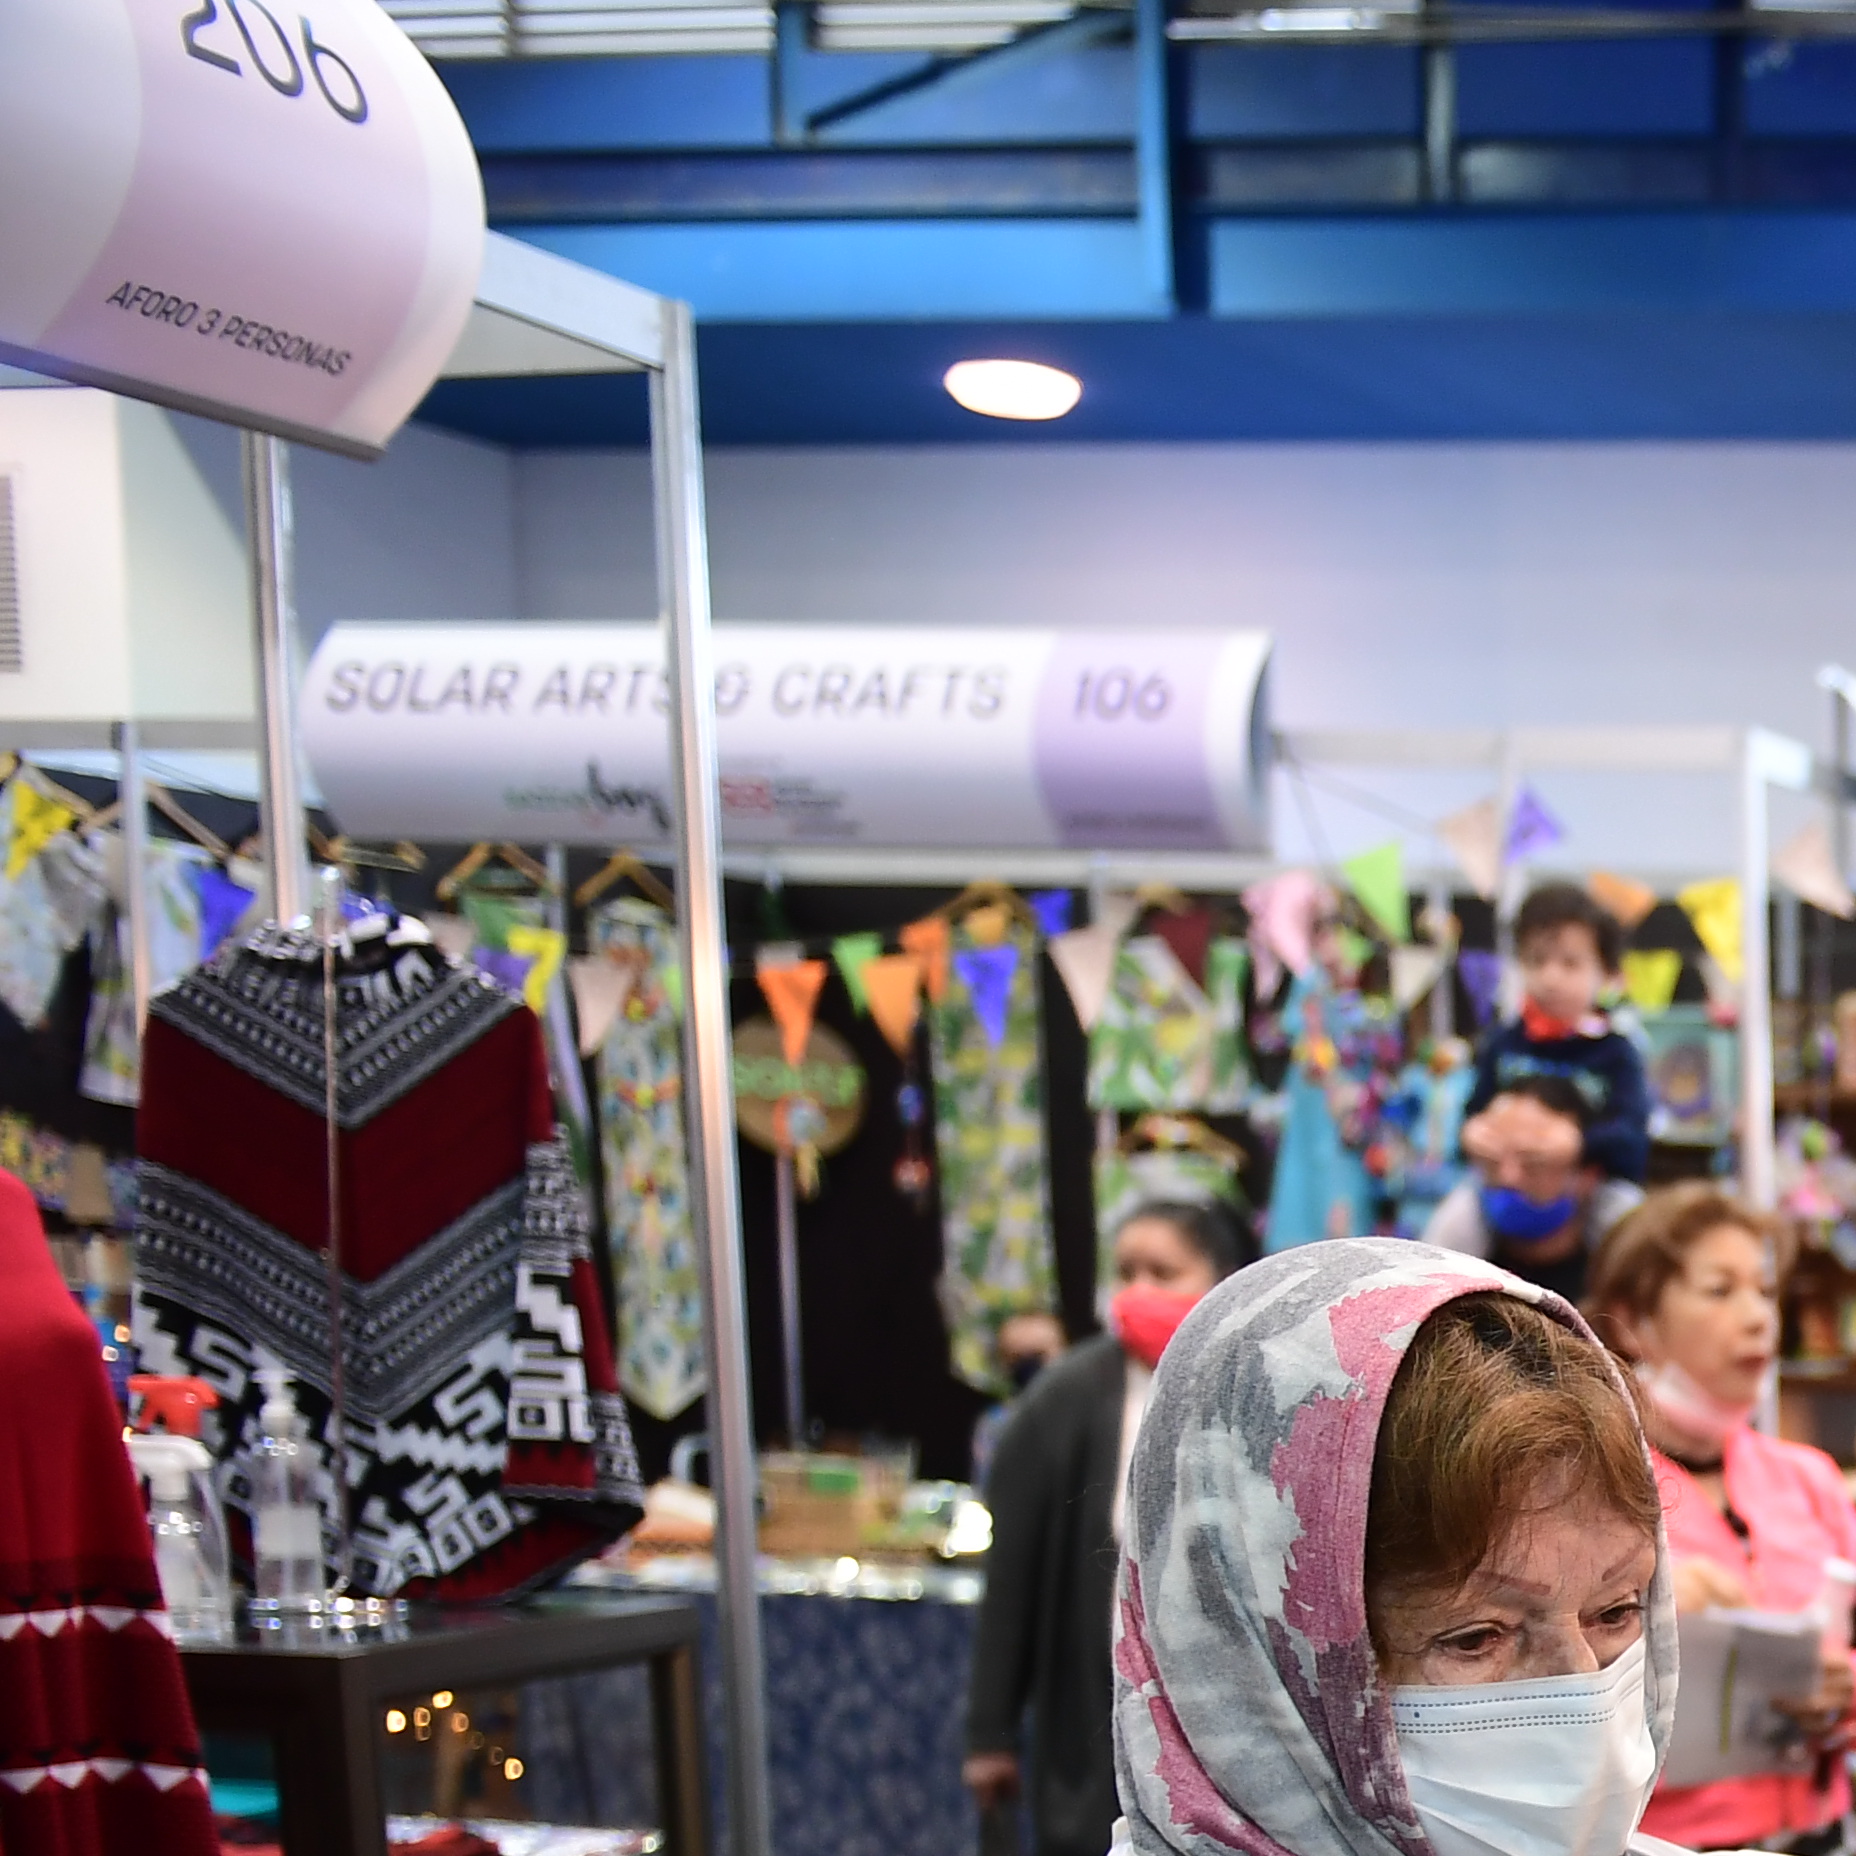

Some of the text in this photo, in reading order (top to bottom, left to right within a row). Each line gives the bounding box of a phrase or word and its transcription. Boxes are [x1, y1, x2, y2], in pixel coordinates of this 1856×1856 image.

[106, 281, 351, 376] AFORO 3 PERSONAS
[326, 662, 518, 714] SOLAR
[772, 664, 1009, 720] CRAFTS
[1074, 667, 1173, 722] 106
